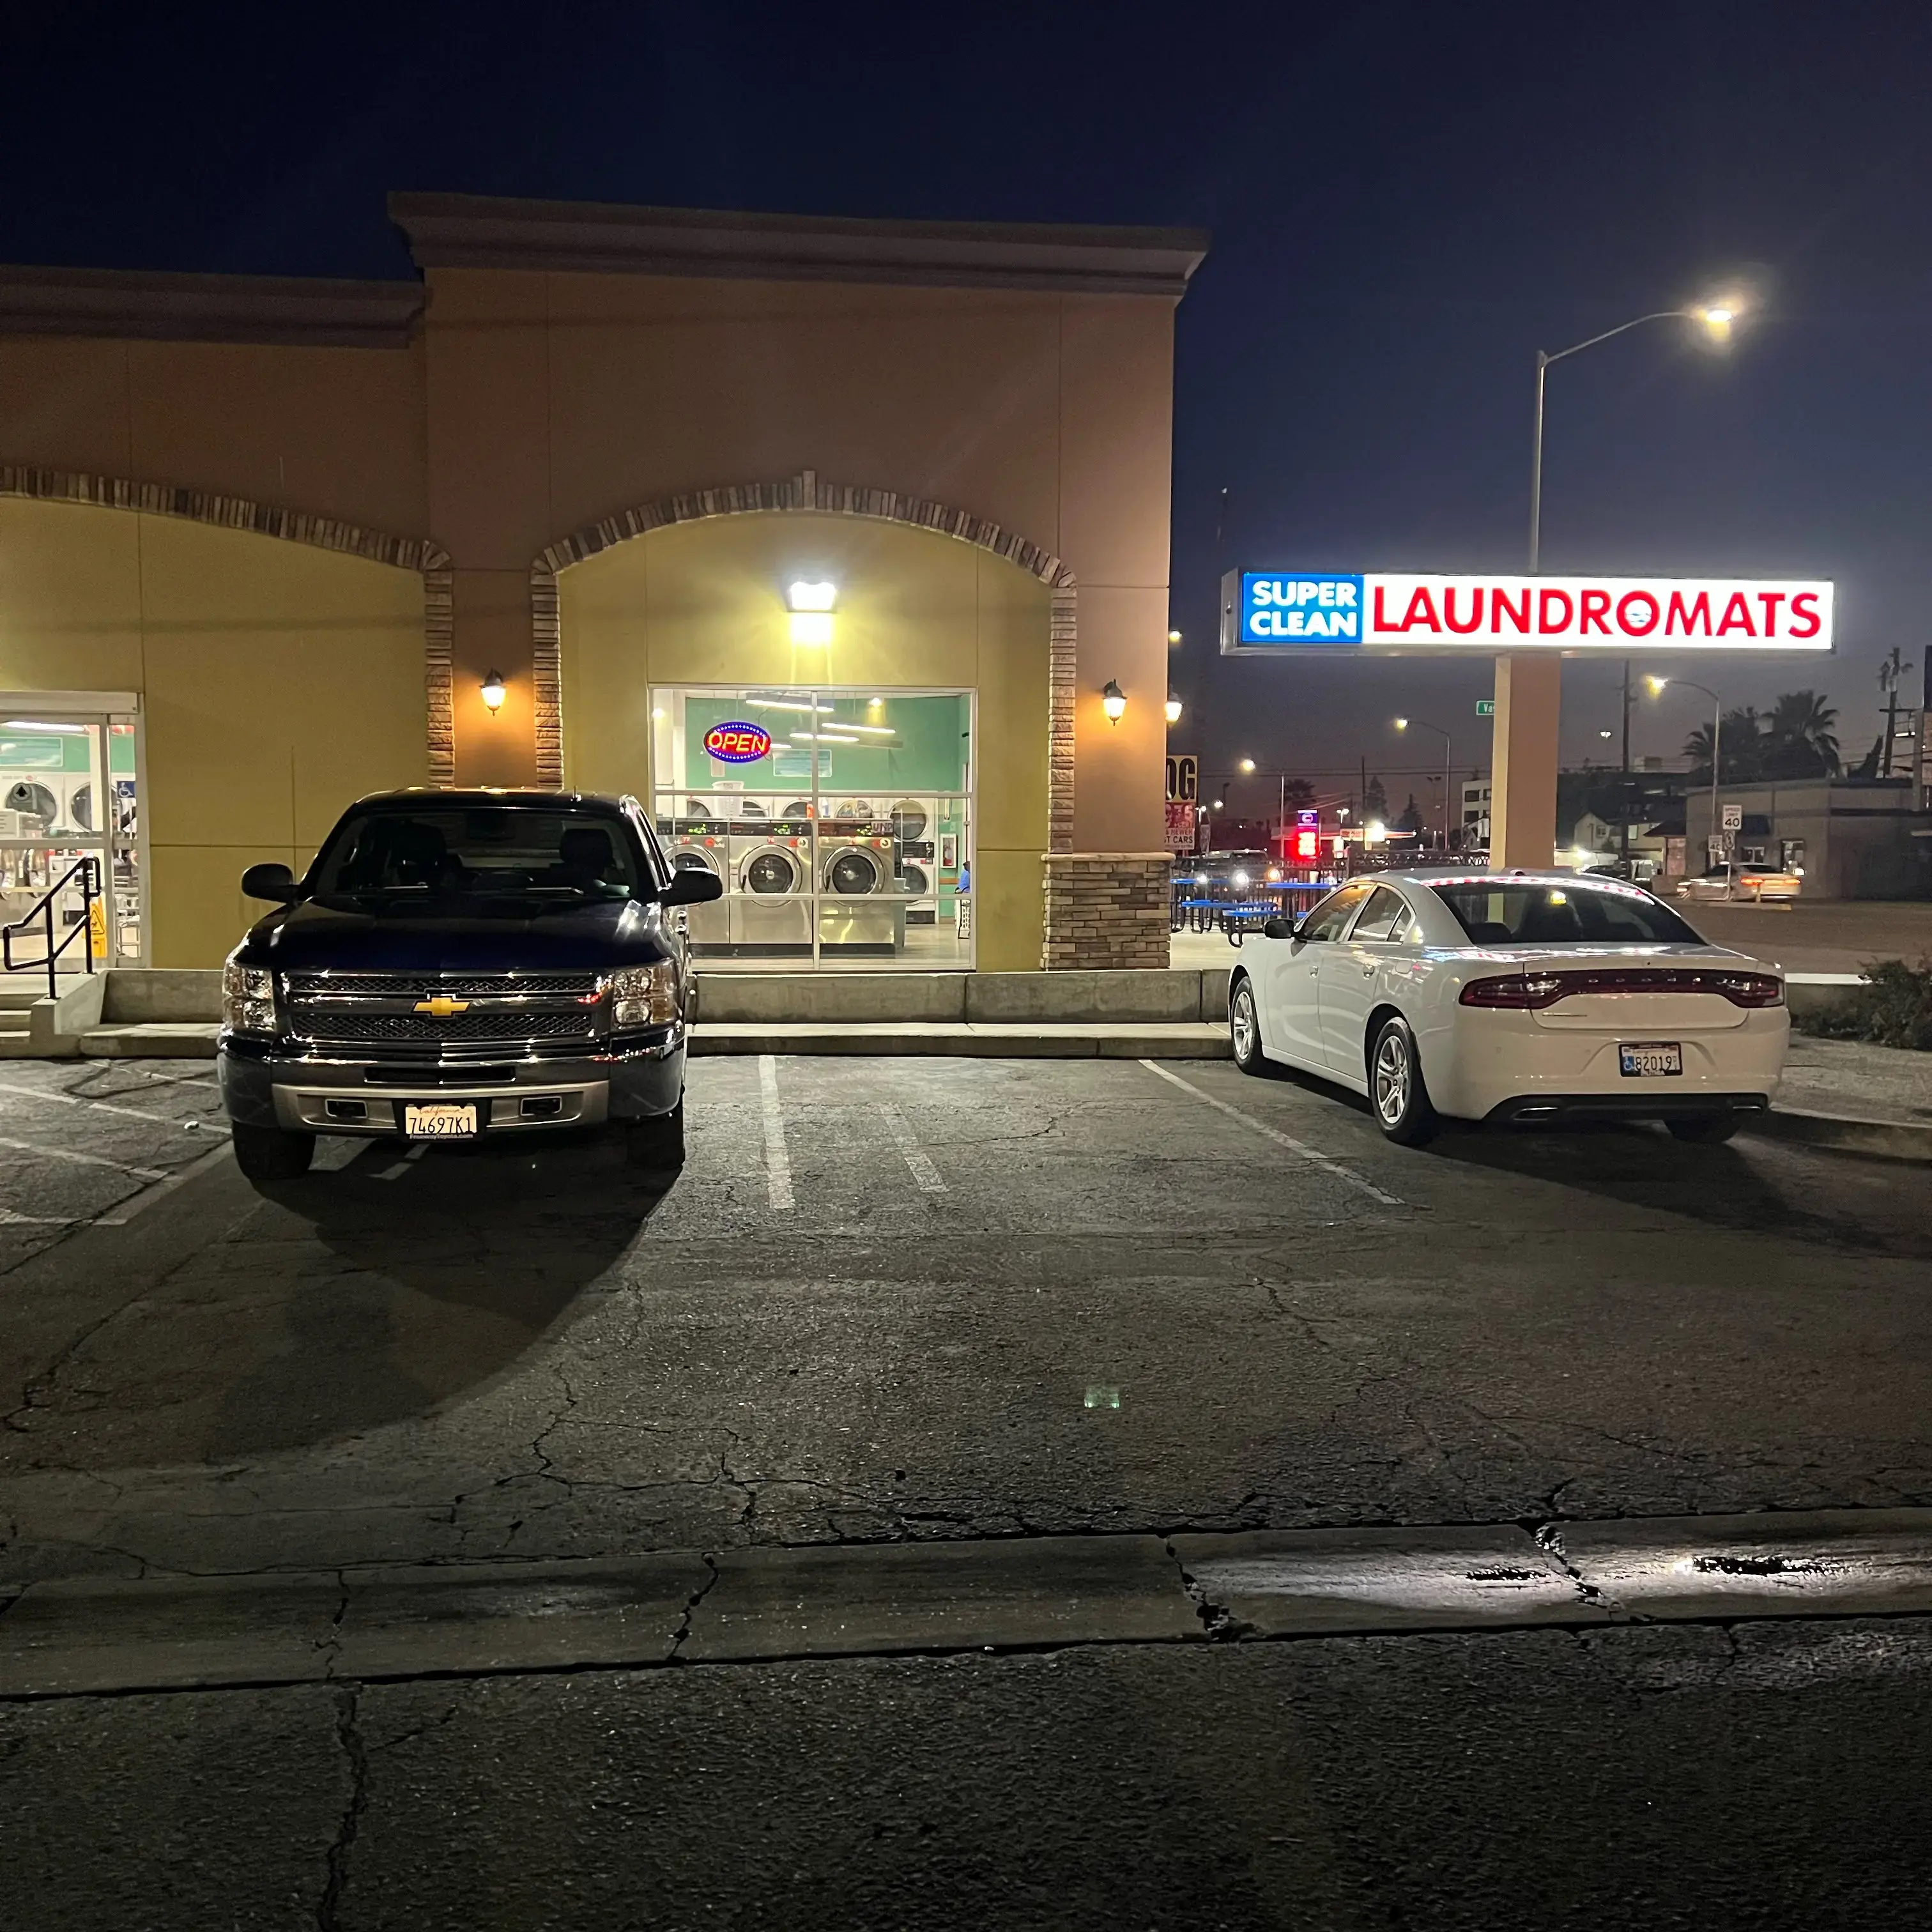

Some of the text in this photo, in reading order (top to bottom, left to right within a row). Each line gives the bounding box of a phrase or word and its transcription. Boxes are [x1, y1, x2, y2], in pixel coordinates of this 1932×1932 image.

[1252, 581, 1357, 606] SUPER
[1374, 586, 1821, 638] LAUNDROMATS
[1250, 611, 1356, 637] CLEAN
[1483, 703, 1495, 712] Va
[708, 732, 767, 751] OPEN
[1725, 818, 1740, 827] 40
[409, 1117, 471, 1134] 74697K1
